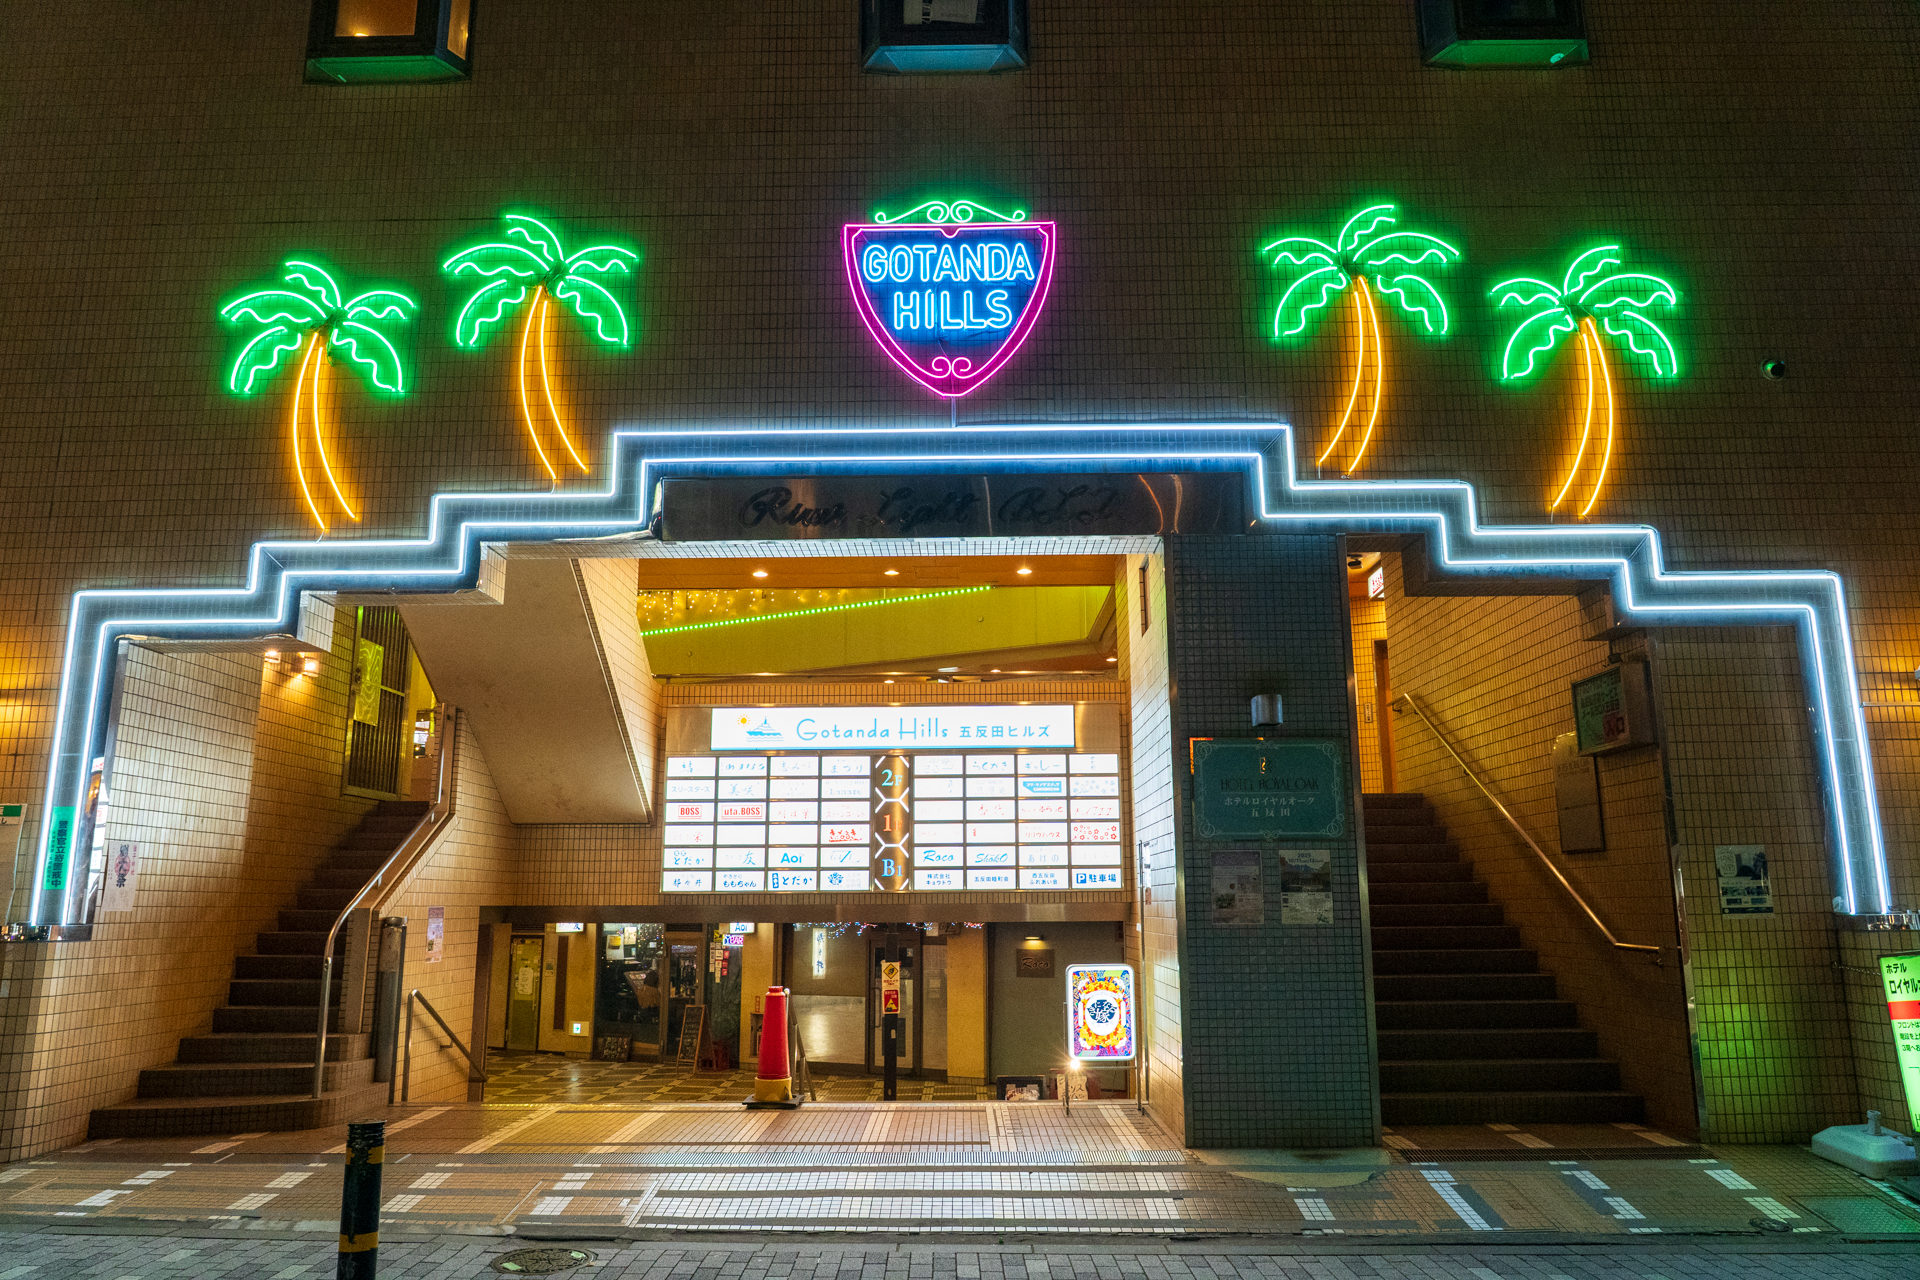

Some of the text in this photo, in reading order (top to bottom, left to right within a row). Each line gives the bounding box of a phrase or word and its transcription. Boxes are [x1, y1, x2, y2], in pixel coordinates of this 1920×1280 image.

[863, 243, 1035, 282] GOTANDA
[894, 289, 1012, 330] HILLS
[796, 717, 1050, 741] Gotanda Hills 五反田ヒルズ
[881, 769, 903, 786] 2F
[1224, 797, 1315, 806] ホテルロイヤルオーク
[680, 806, 700, 816] BOSS
[724, 806, 761, 816] uta.BOSS
[882, 814, 904, 831] 1F
[673, 857, 705, 866] とだか
[780, 852, 803, 863] Aoi
[923, 850, 954, 862] Roco
[881, 858, 903, 877] B1
[782, 876, 813, 886] とだか
[1088, 873, 1117, 883] 駐車場
[723, 880, 757, 888] ももちゃん
[1021, 956, 1051, 970] Roco
[1886, 963, 1907, 974] ホテル
